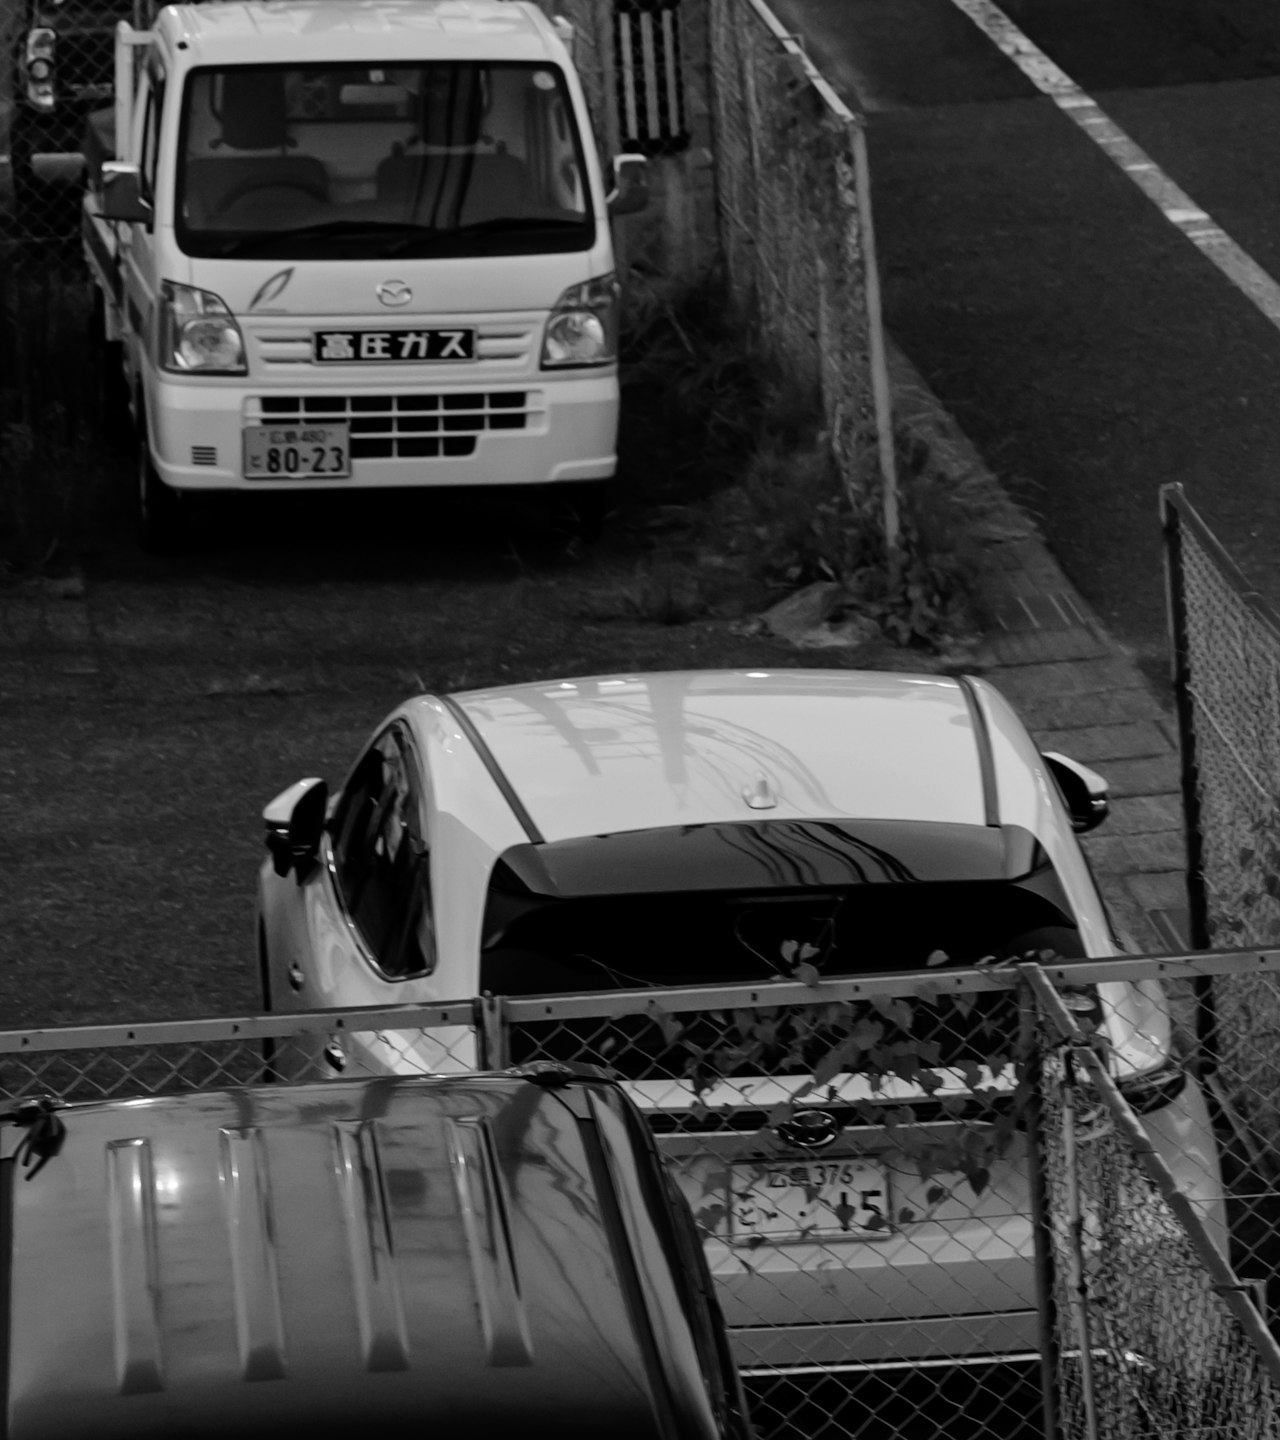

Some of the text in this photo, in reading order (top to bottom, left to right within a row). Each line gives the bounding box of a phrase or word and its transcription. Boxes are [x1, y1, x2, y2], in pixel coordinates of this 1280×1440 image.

[321, 331, 468, 360] 高圧ガス
[267, 446, 344, 474] 80-23
